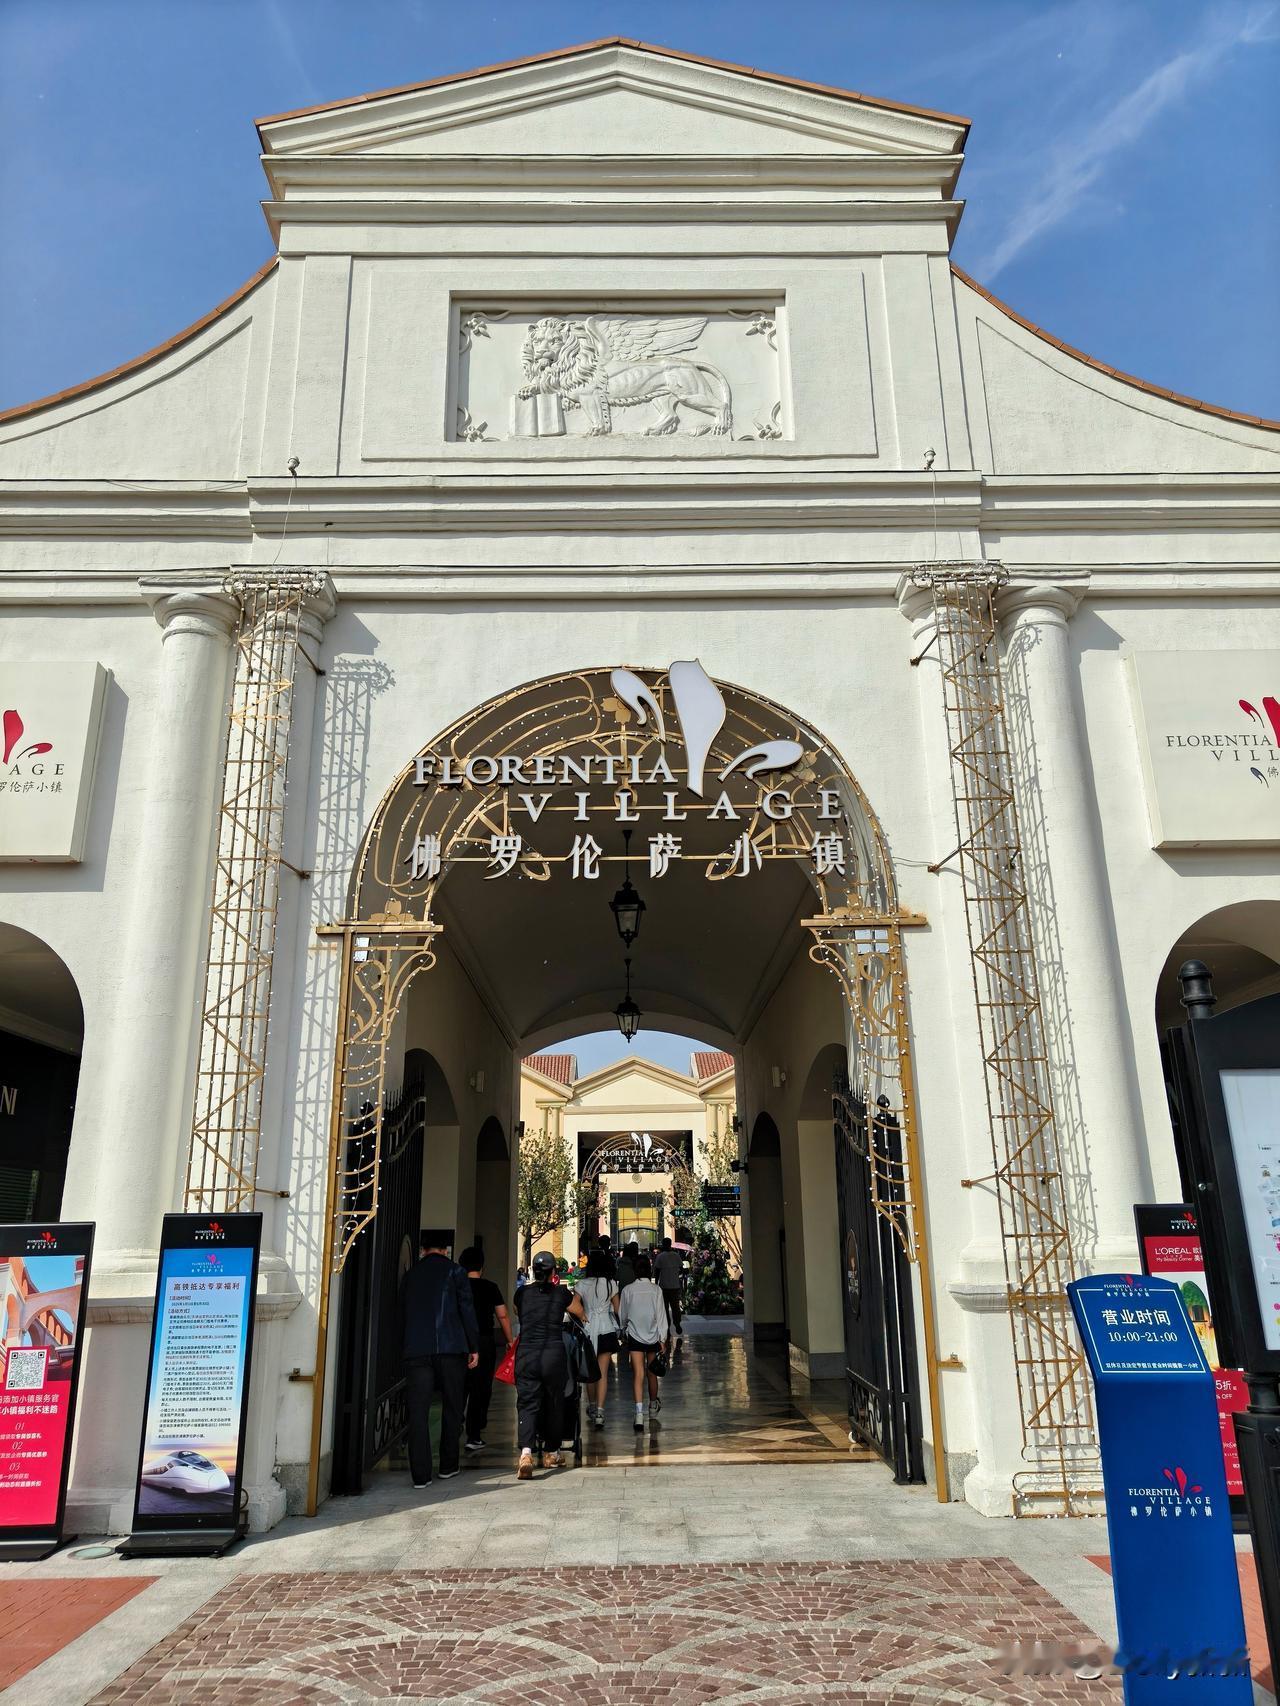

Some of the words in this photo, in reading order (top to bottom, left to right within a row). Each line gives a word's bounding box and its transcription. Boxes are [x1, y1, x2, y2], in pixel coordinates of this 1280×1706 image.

[1165, 735, 1273, 748] FLORENTIA
[8, 763, 65, 776] AGE
[412, 755, 679, 786] FLORENTIA
[517, 789, 842, 823] VILLAGE
[403, 831, 847, 881] 佛罗伦萨小镇
[601, 1149, 645, 1157] FLORENTIA
[173, 1282, 240, 1291] 高铁抵达专享福利
[1101, 1309, 1172, 1326] 营业时间
[1107, 1331, 1178, 1343] 10:00-21:00
[0, 1404, 58, 1415] 小镇福利不迷路
[15, 1422, 25, 1431] 01
[12, 1441, 24, 1450] 02
[9, 1462, 21, 1471] 03
[1128, 1488, 1180, 1496] FLORENTIA
[1149, 1496, 1212, 1505] VILLAGE
